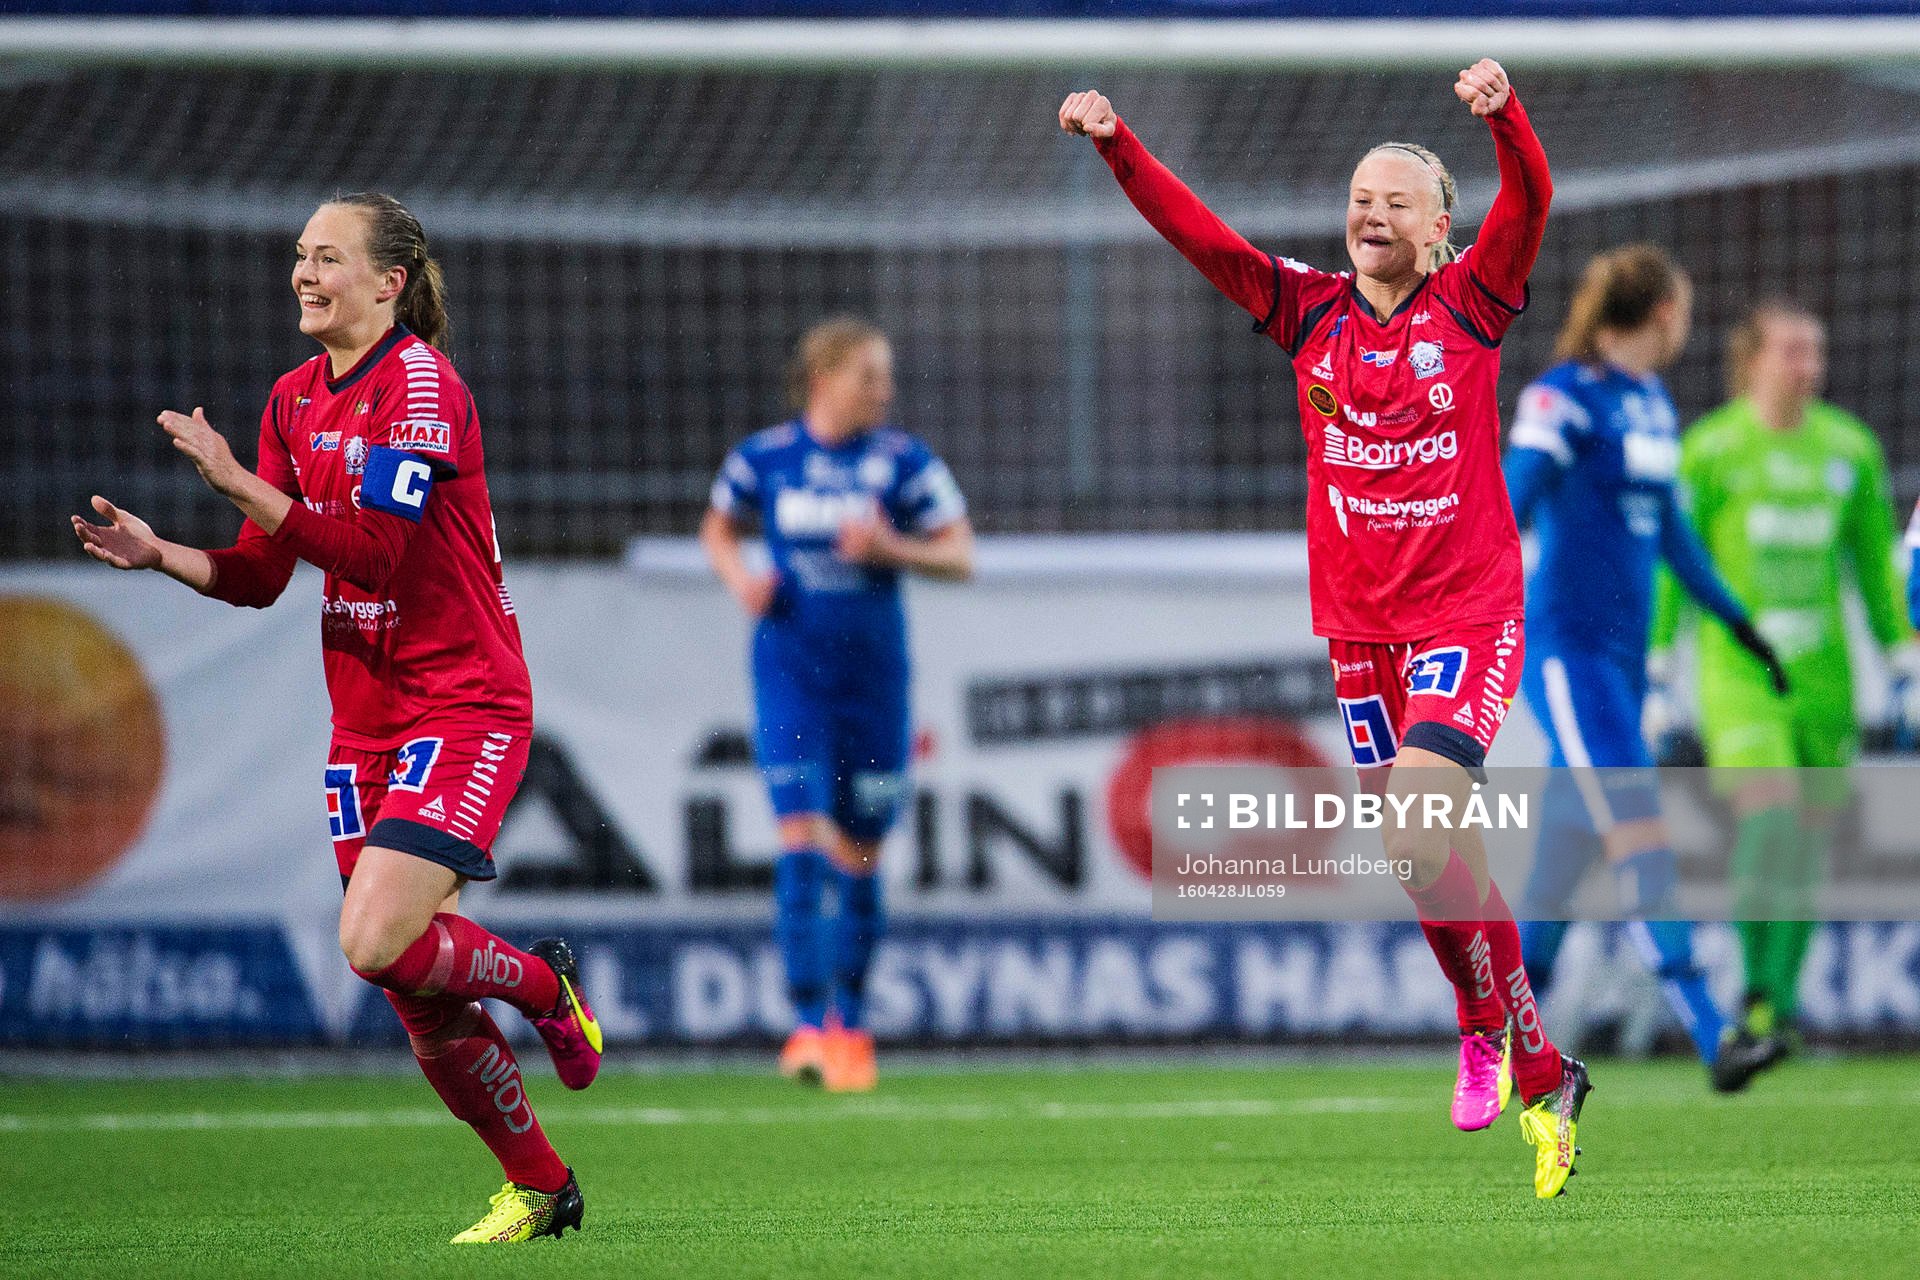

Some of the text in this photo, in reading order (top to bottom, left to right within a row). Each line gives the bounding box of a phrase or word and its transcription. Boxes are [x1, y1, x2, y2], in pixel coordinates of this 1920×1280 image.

[391, 424, 448, 445] MAXI
[1347, 431, 1458, 465] Botrygg
[391, 460, 431, 507] C
[1347, 493, 1459, 517] Riksbyggen
[1453, 713, 1475, 728] SELECT
[418, 807, 446, 823] SELECT
[864, 940, 1216, 1034] SYNAS
